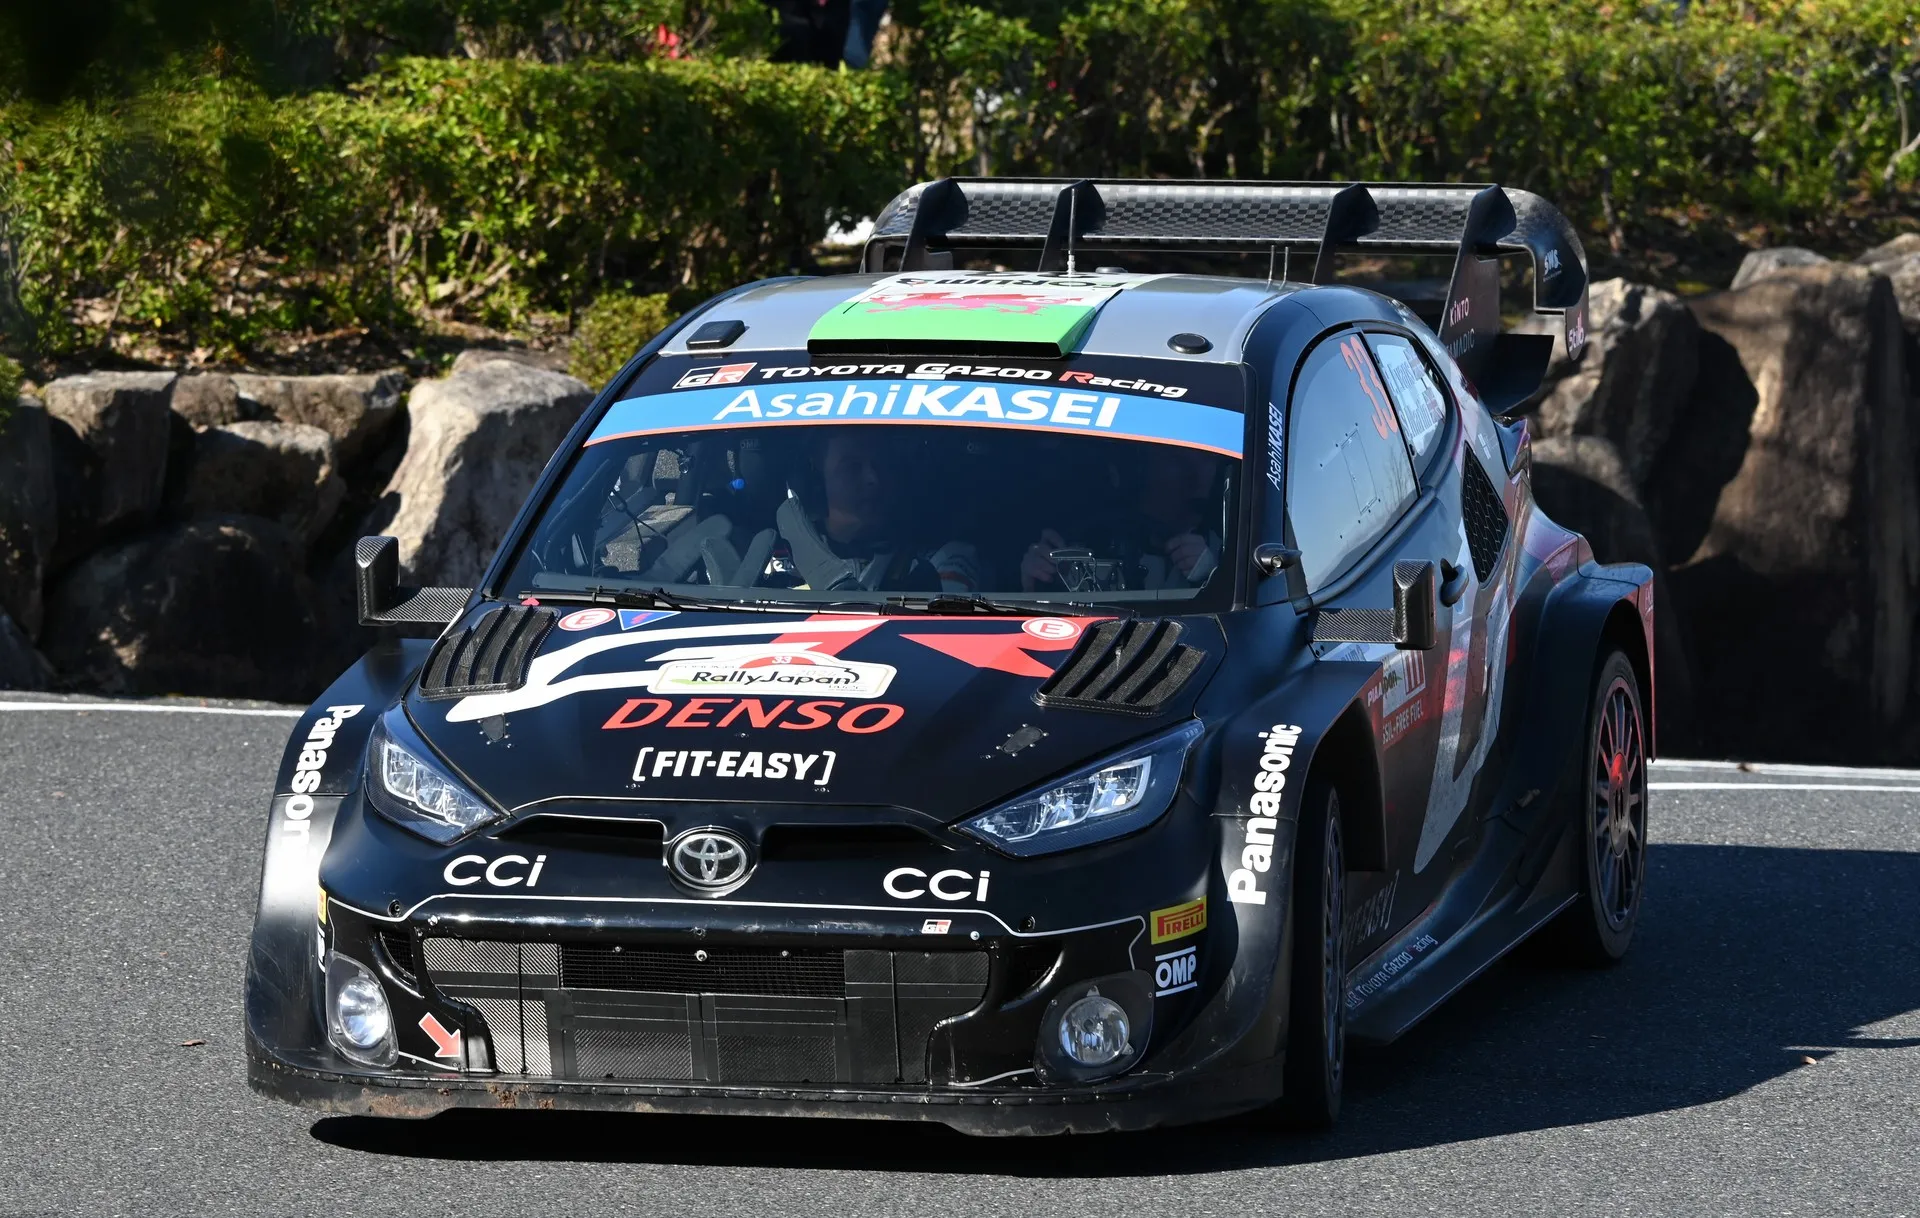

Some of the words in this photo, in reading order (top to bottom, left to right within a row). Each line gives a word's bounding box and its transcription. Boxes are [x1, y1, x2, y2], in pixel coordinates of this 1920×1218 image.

[1446, 328, 1475, 358] AMADIC
[675, 363, 754, 388] GR
[758, 363, 906, 380] TOYOTA
[906, 362, 1052, 380] GAZOO
[1058, 370, 1188, 397] Racing
[1340, 336, 1399, 440] 33
[1038, 623, 1068, 636] E
[771, 656, 793, 664] 33
[601, 697, 905, 734] DENSO
[283, 704, 365, 850] Panason
[1227, 723, 1302, 905] Panasonic
[1157, 903, 1205, 937] PIRELLI
[1156, 950, 1196, 988] OMP
[1356, 971, 1389, 997] TOYOTA
[1383, 951, 1414, 977] GAZOO
